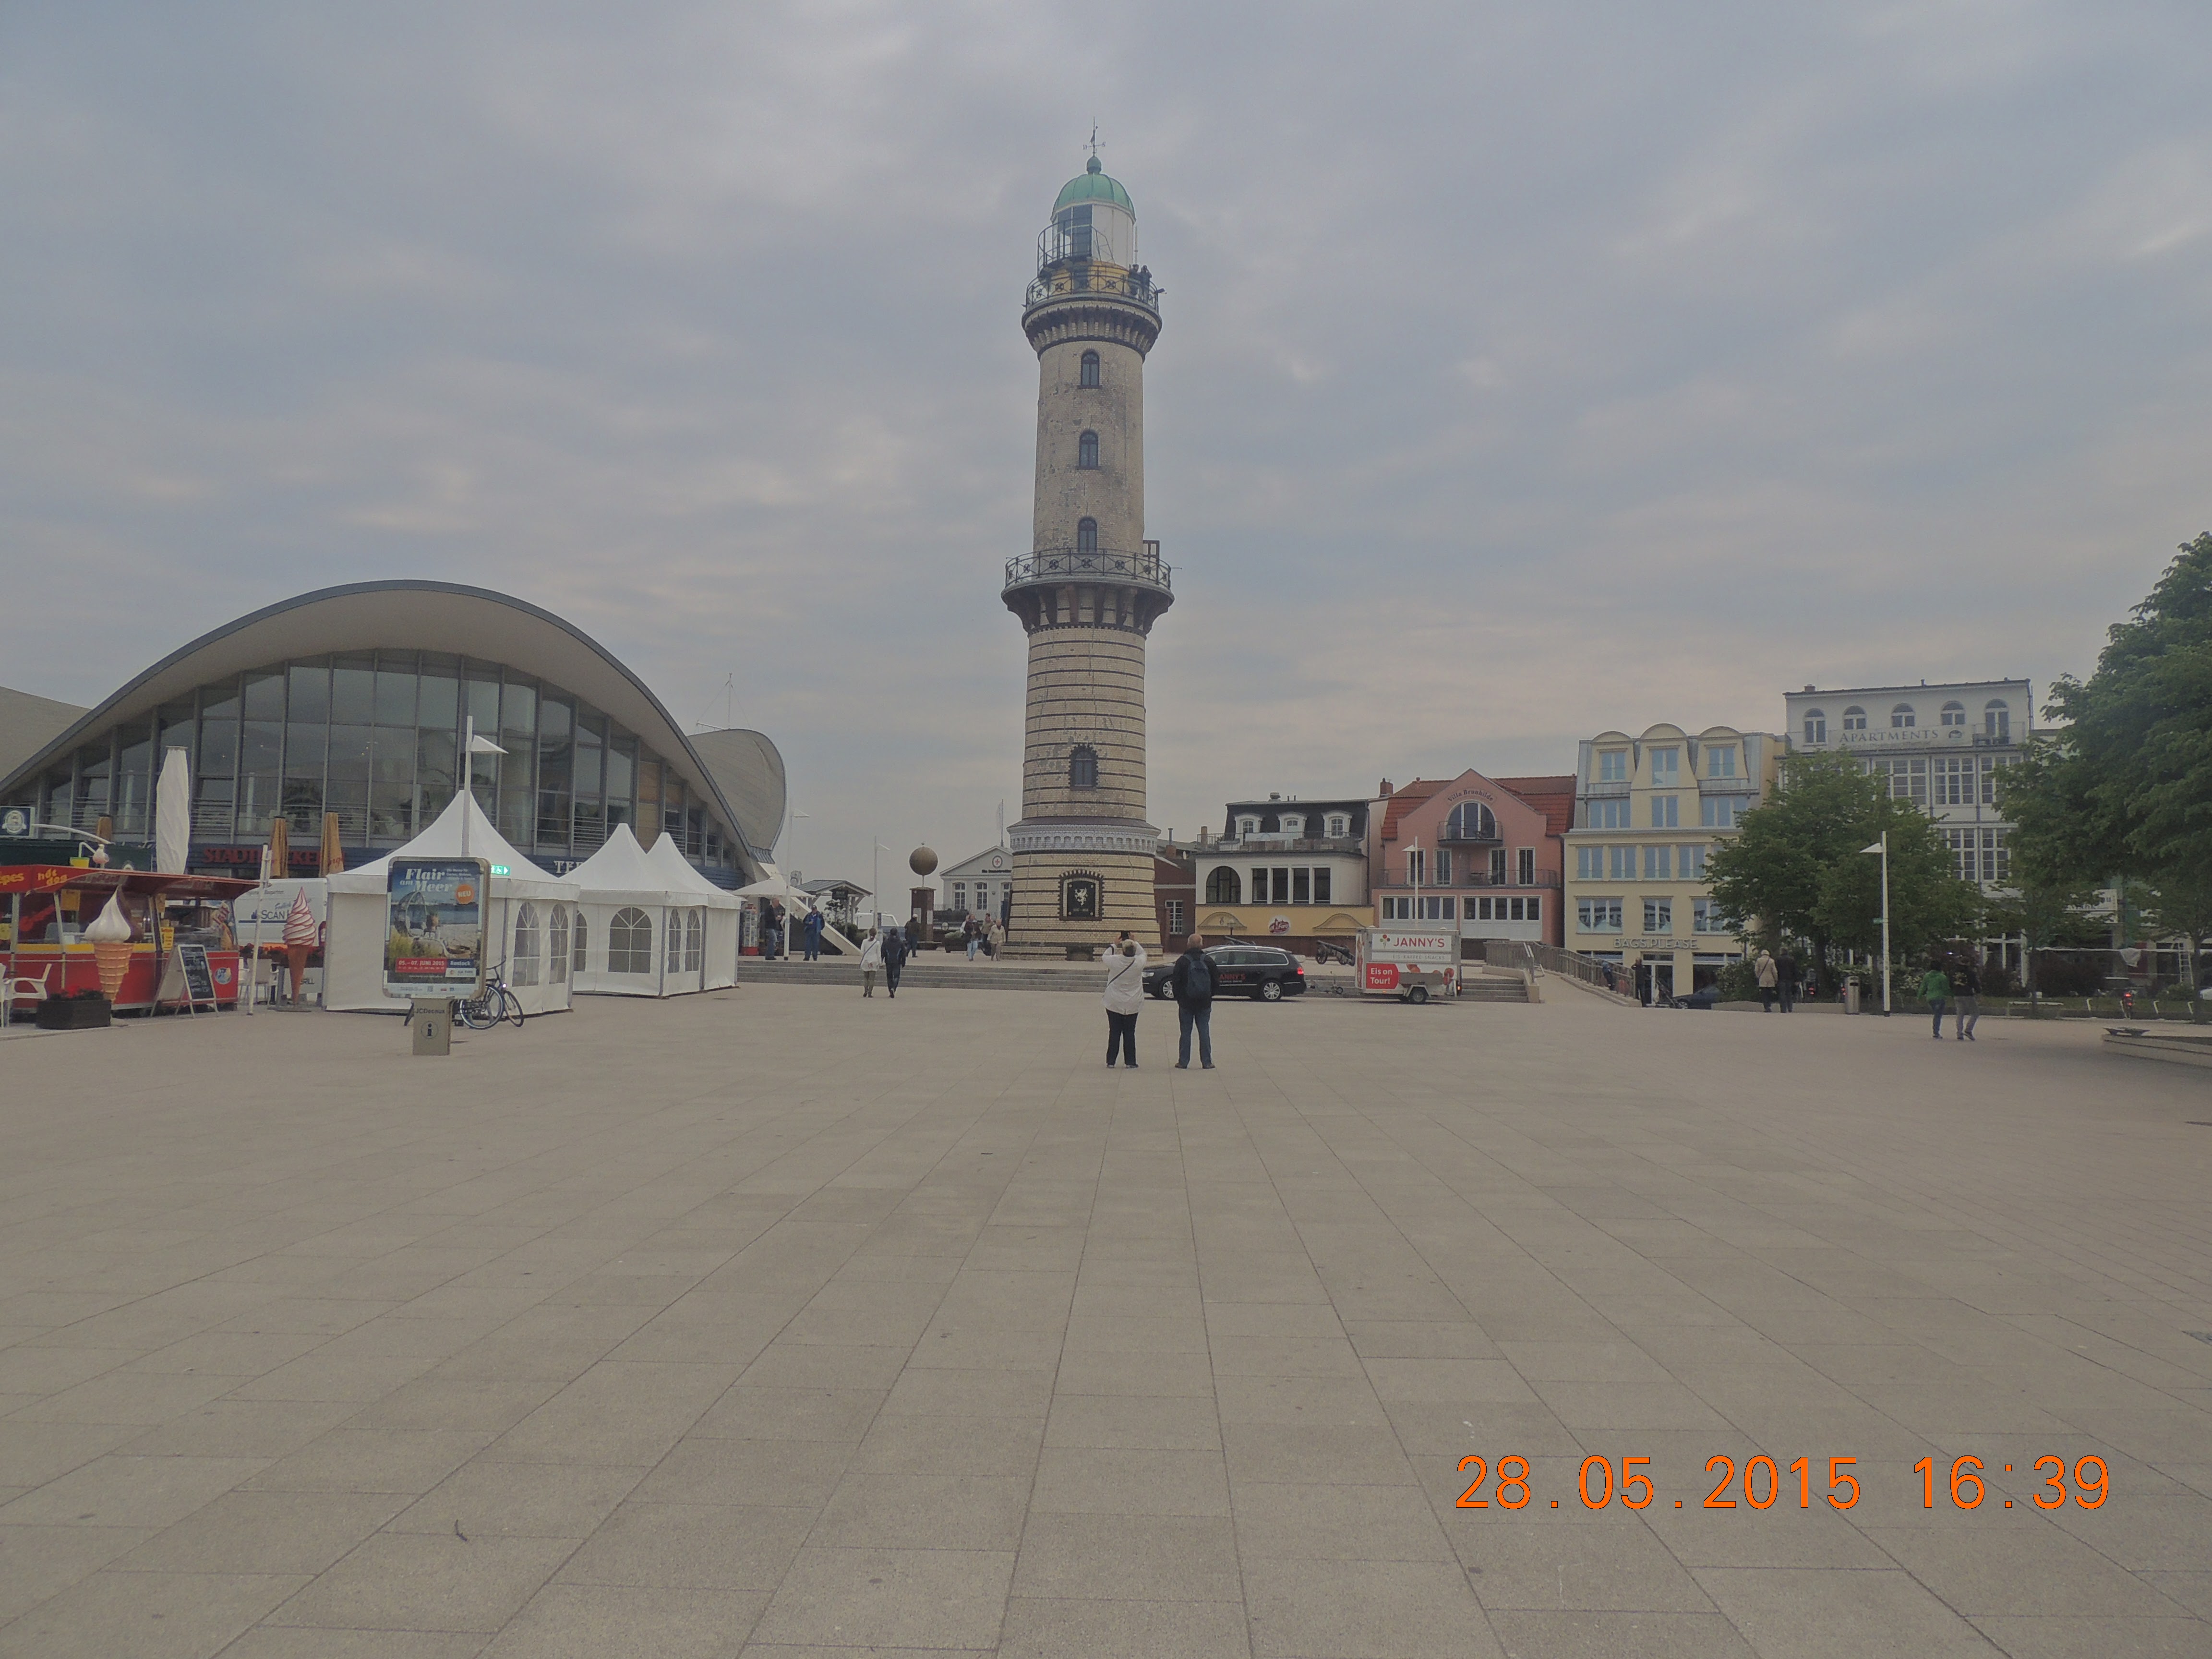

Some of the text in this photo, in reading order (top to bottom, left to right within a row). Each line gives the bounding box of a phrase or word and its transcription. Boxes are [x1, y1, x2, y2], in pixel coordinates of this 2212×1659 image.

[1839, 730, 1938, 743] APARTMENTS
[1447, 789, 1493, 802] Villa Brunhilde
[37, 868, 57, 881] hot
[405, 868, 445, 880] Flair
[413, 880, 453, 892] Meer
[261, 910, 285, 919] SCAN
[1393, 938, 1445, 948] JANNY'S
